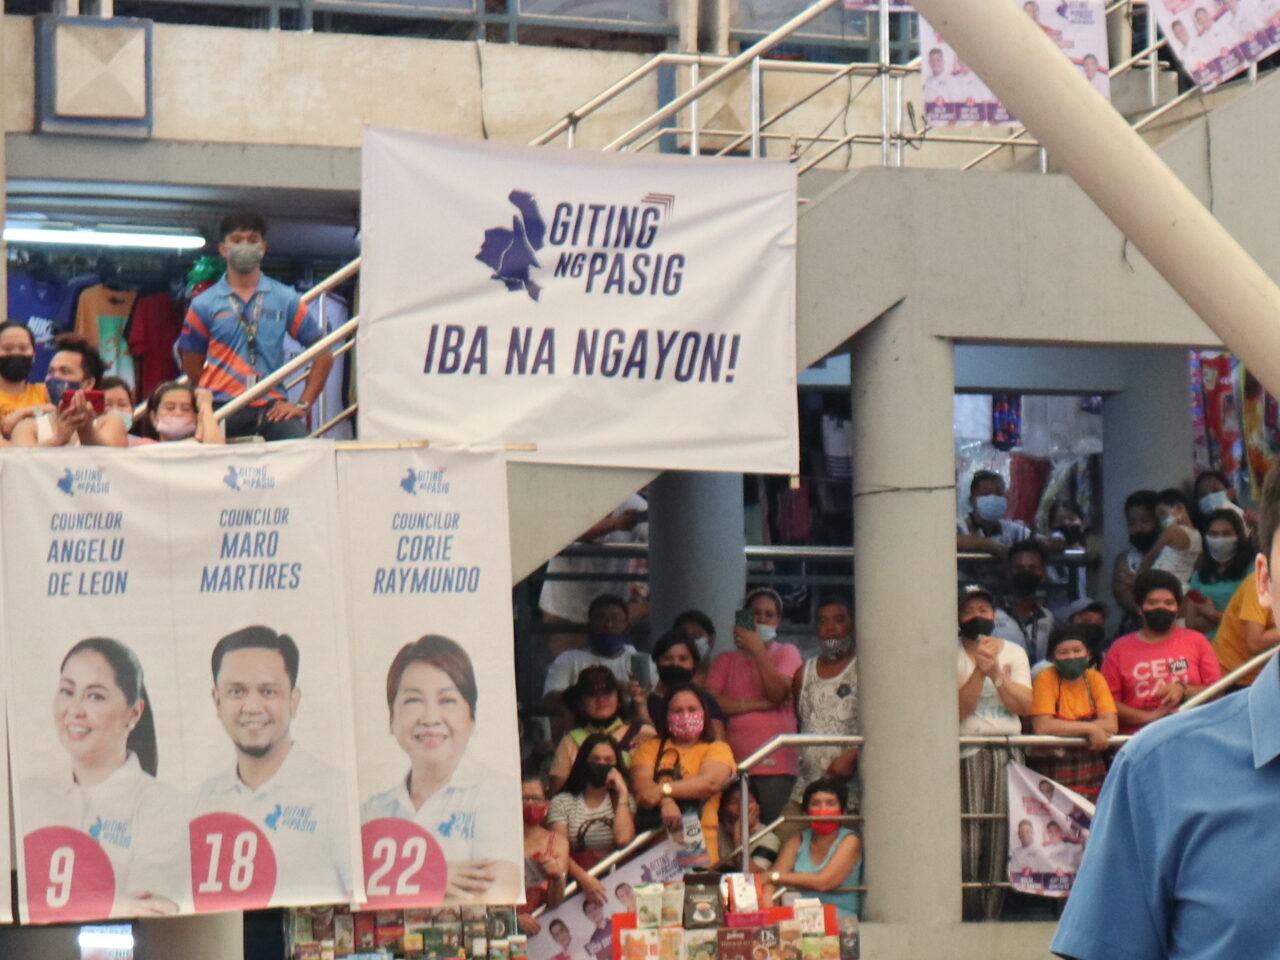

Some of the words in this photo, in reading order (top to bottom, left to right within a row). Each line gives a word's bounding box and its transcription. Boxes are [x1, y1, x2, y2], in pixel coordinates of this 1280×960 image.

[550, 202, 661, 250] GITING
[554, 252, 587, 278] NG
[585, 252, 686, 297] PASIG
[423, 323, 489, 376] IBA
[504, 326, 556, 376] NA
[573, 327, 742, 383] NGAYON!
[84, 482, 111, 494] PASIG
[250, 476, 276, 489] PASIG
[426, 480, 450, 494] PASIG
[51, 511, 123, 531] COUNCILOR
[219, 507, 290, 527] COUNCILOR
[392, 512, 460, 530] COUNCILOR
[47, 538, 125, 563] ANGELU
[220, 531, 280, 559] MARO
[396, 535, 454, 562] CORIE
[47, 572, 72, 596] DE
[78, 570, 128, 595] LEON
[200, 562, 302, 593] MARTIRES
[373, 566, 480, 594] RAYMUNDO
[198, 830, 258, 893] 18
[366, 835, 428, 896] 22
[46, 846, 76, 909] 9
